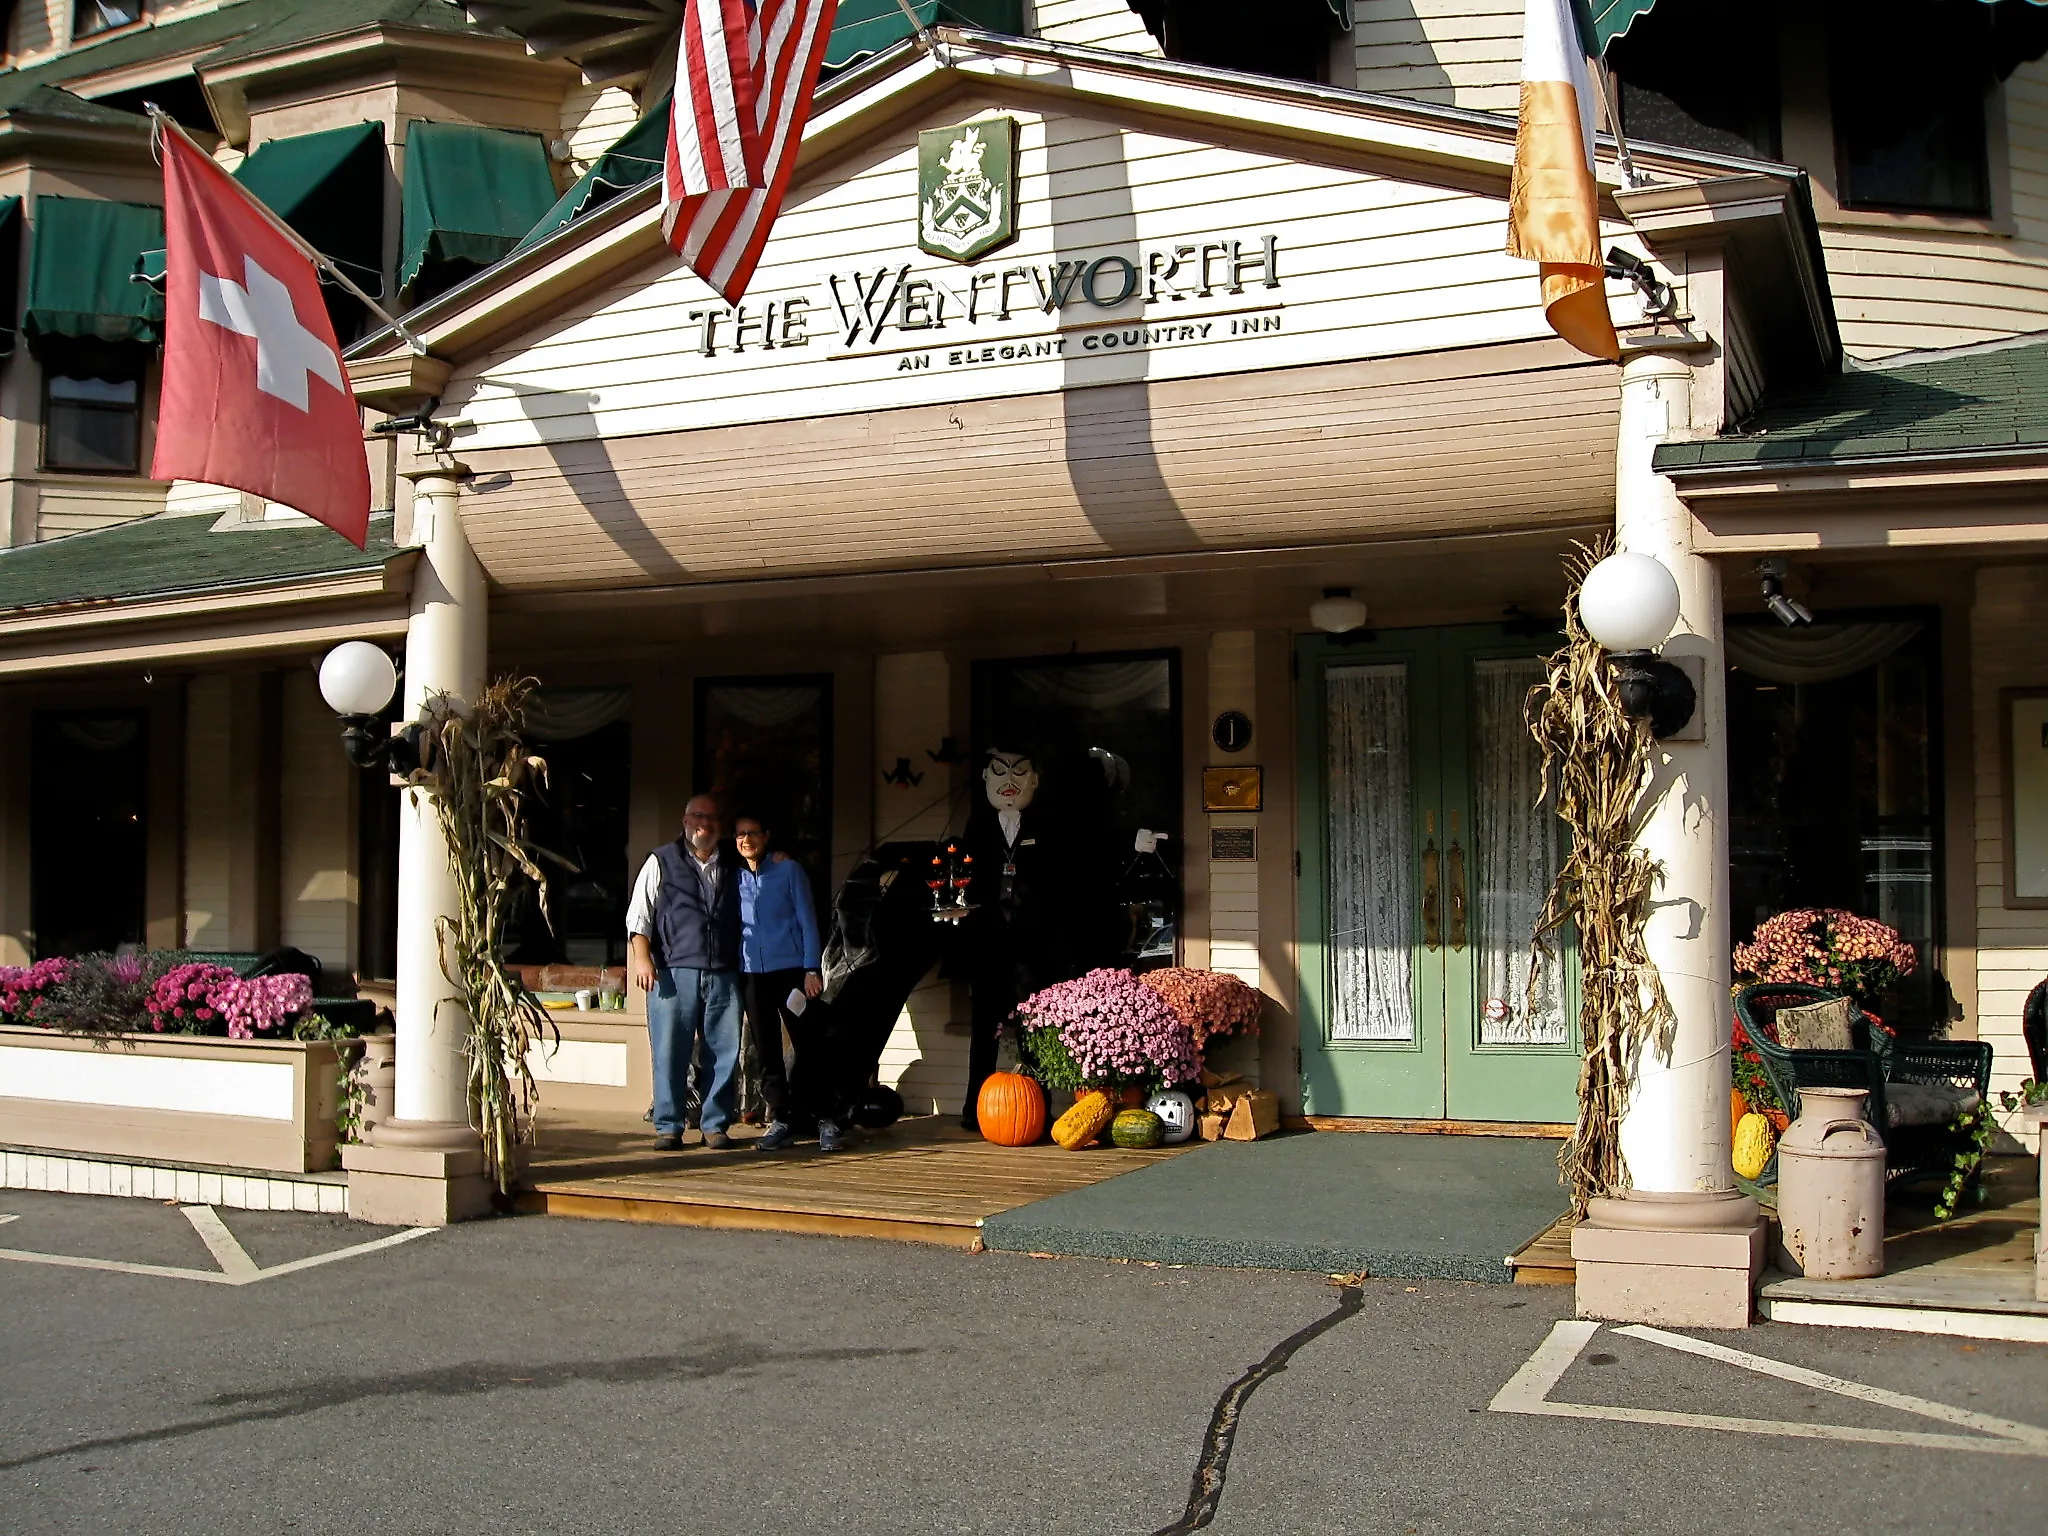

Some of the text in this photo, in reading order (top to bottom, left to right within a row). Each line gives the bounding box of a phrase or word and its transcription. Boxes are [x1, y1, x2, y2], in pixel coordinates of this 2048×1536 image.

[689, 234, 1281, 357] THE WENTWORTH
[897, 315, 1281, 371] AN ELEGANT COUNTRY INN
